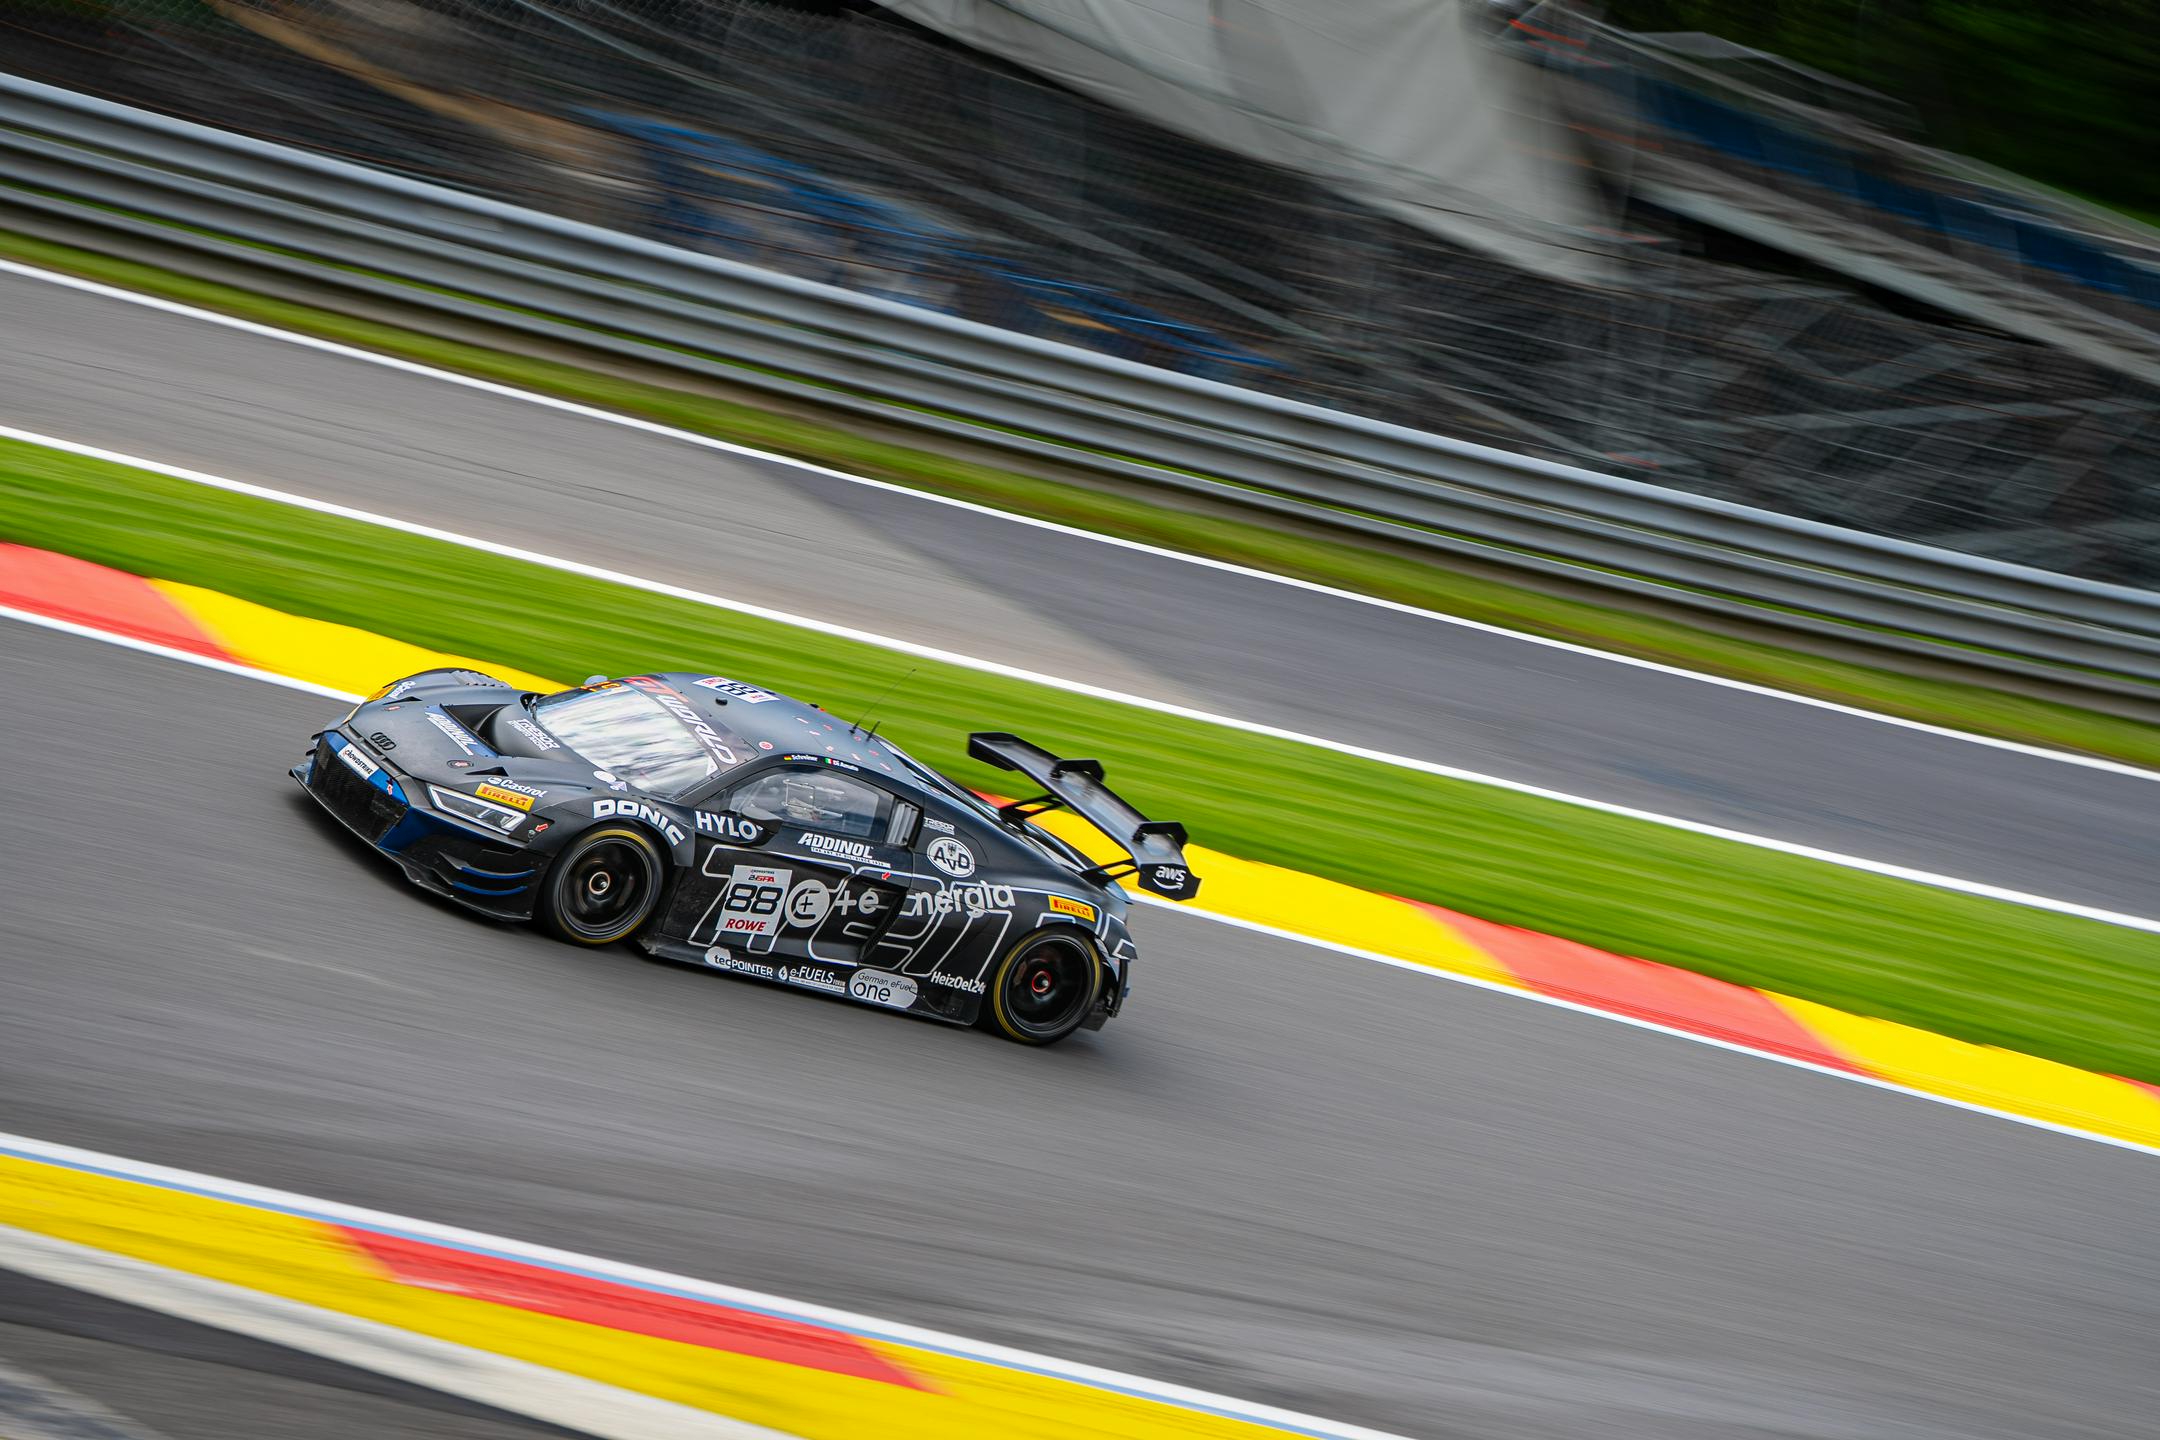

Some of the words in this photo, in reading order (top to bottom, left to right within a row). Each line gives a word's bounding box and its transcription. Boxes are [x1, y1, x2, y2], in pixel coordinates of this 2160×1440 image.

[517, 718, 561, 749] TRESOR
[656, 694, 738, 765] WORLD
[343, 749, 374, 776] CROWDSTRIKE
[481, 784, 529, 807] PIRELLI
[500, 779, 548, 798] Castrol
[593, 799, 685, 846] DONIC
[695, 811, 757, 841] HYLO
[797, 832, 874, 859] ADDINOL
[1156, 865, 1187, 882] aws
[724, 883, 783, 915] 88
[1053, 899, 1091, 918] PIRELLI
[725, 918, 767, 932] ROWE
[714, 954, 774, 977] tecPOINTER
[790, 966, 835, 985] e-FUELS
[857, 972, 888, 986] German
[930, 971, 987, 995] HeizOel24
[853, 981, 891, 1003] one
